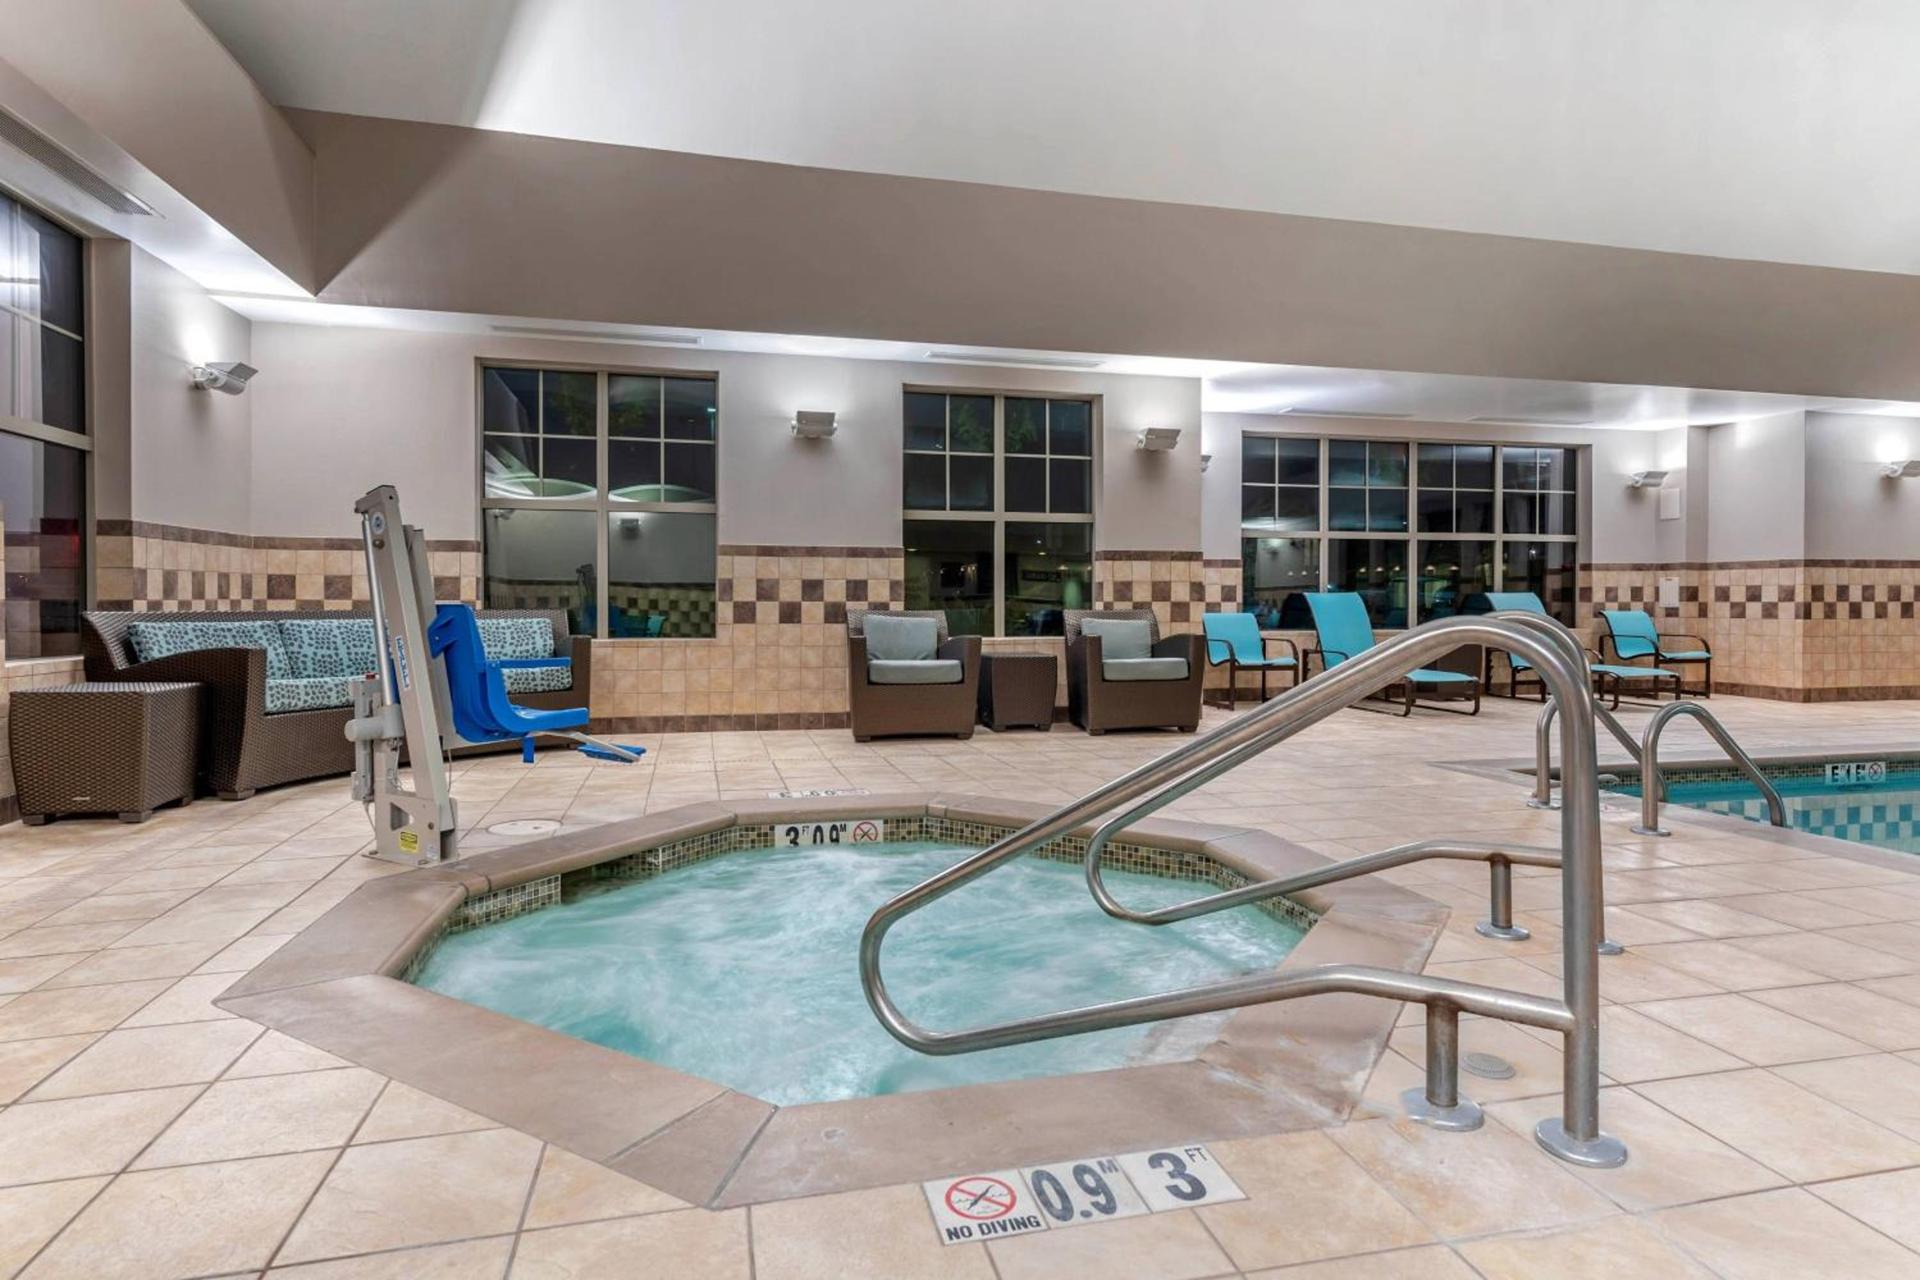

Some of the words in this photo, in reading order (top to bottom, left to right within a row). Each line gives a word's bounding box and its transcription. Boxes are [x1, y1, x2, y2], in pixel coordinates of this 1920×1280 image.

[1031, 1163, 1118, 1222] 0.9
[1098, 1158, 1119, 1174] M
[1148, 1152, 1207, 1202] 3
[1184, 1147, 1207, 1163] FT
[946, 1225, 973, 1241] NO
[978, 1214, 1042, 1236] DIVING
